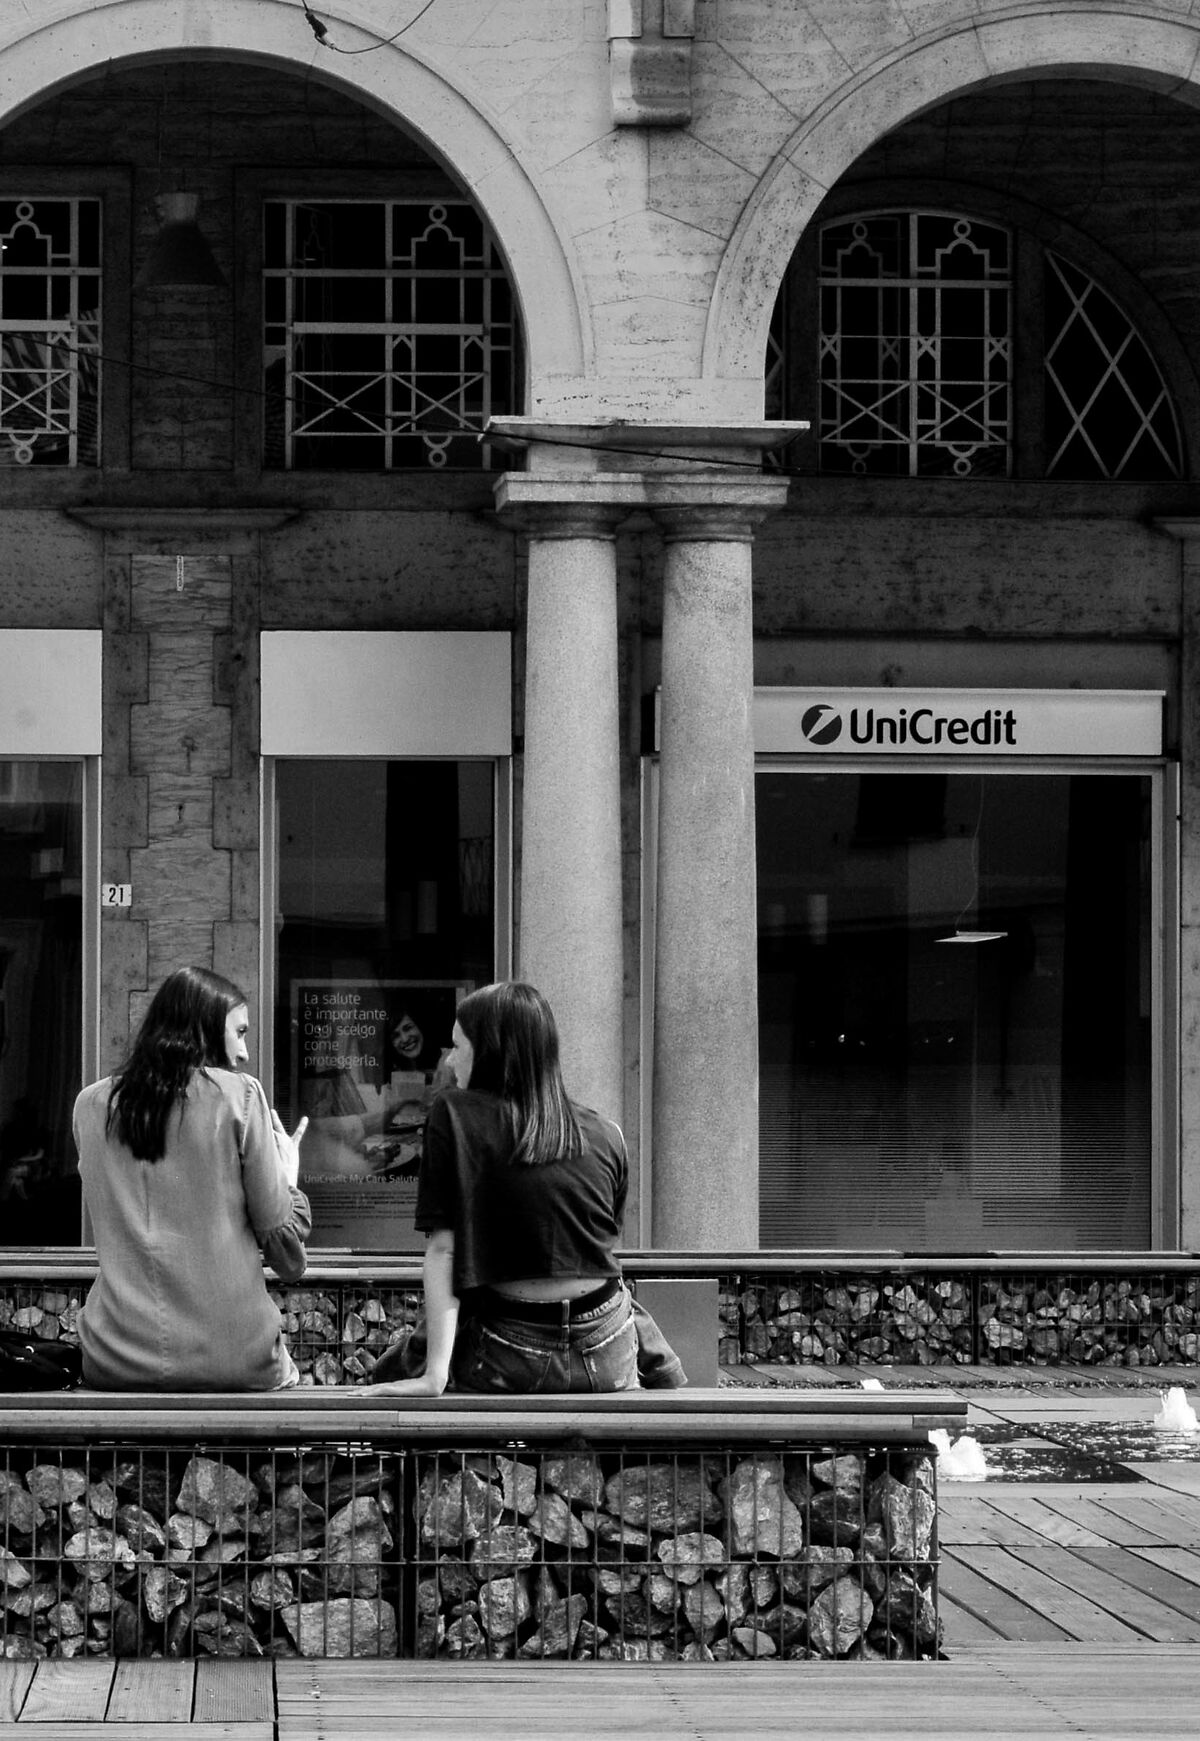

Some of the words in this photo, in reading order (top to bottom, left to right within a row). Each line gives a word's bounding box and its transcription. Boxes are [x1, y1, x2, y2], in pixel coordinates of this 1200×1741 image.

[850, 708, 1017, 745] UniCredit
[109, 887, 124, 903] 21
[304, 991, 318, 1005] La
[322, 991, 361, 1005] salute
[304, 1006, 312, 1020] è
[316, 1006, 390, 1023] importante.
[304, 1022, 332, 1039] Oggi
[336, 1023, 376, 1039] scelgo
[304, 1040, 340, 1052] come
[304, 1053, 380, 1070] proteggerla.
[366, 1173, 387, 1184] Care
